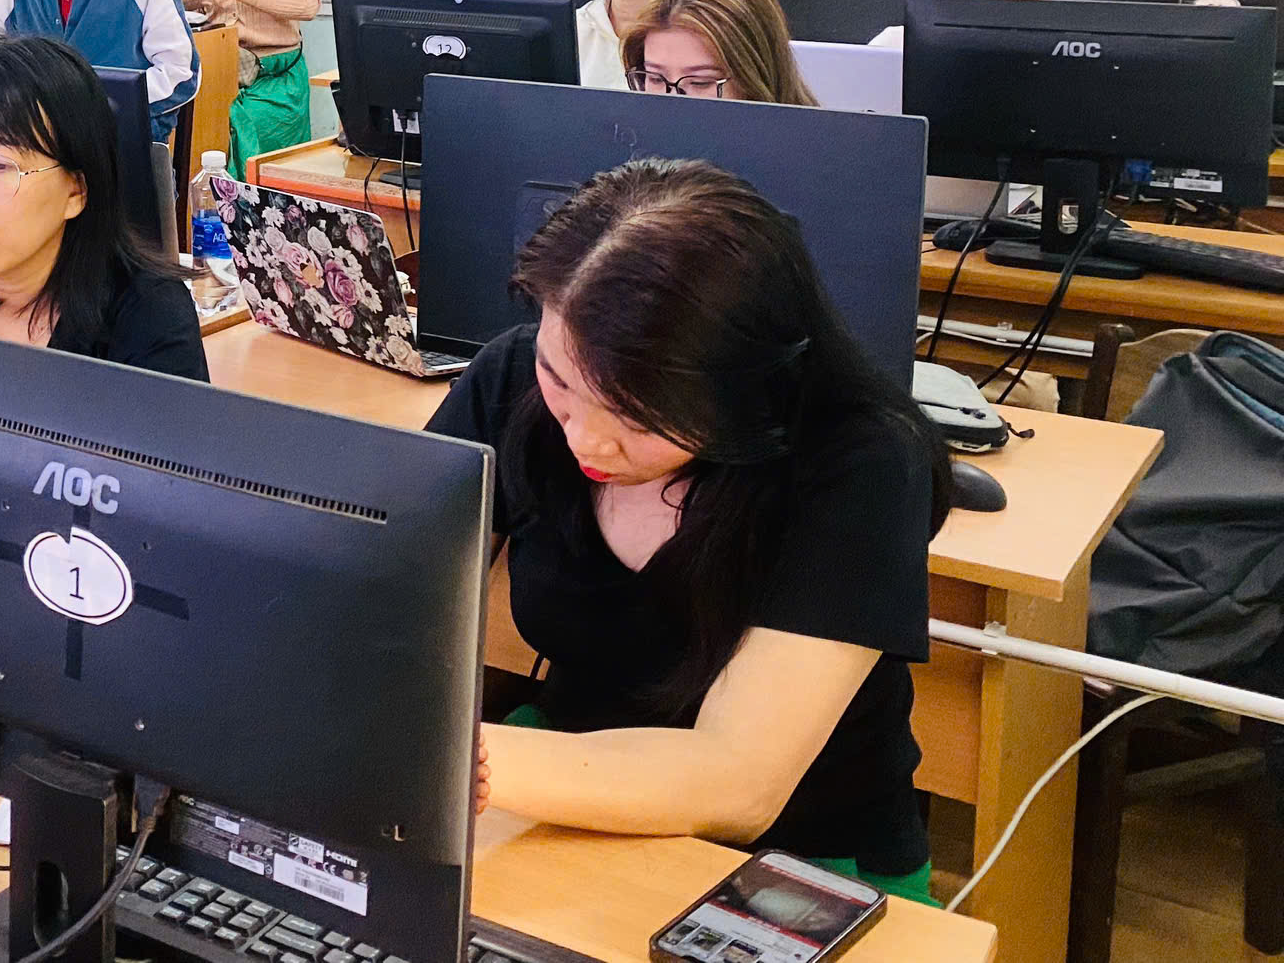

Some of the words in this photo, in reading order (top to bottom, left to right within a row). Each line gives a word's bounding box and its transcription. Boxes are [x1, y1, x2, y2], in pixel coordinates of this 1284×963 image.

[1051, 40, 1101, 58] AOC
[32, 461, 121, 515] AOC
[69, 566, 85, 600] 1
